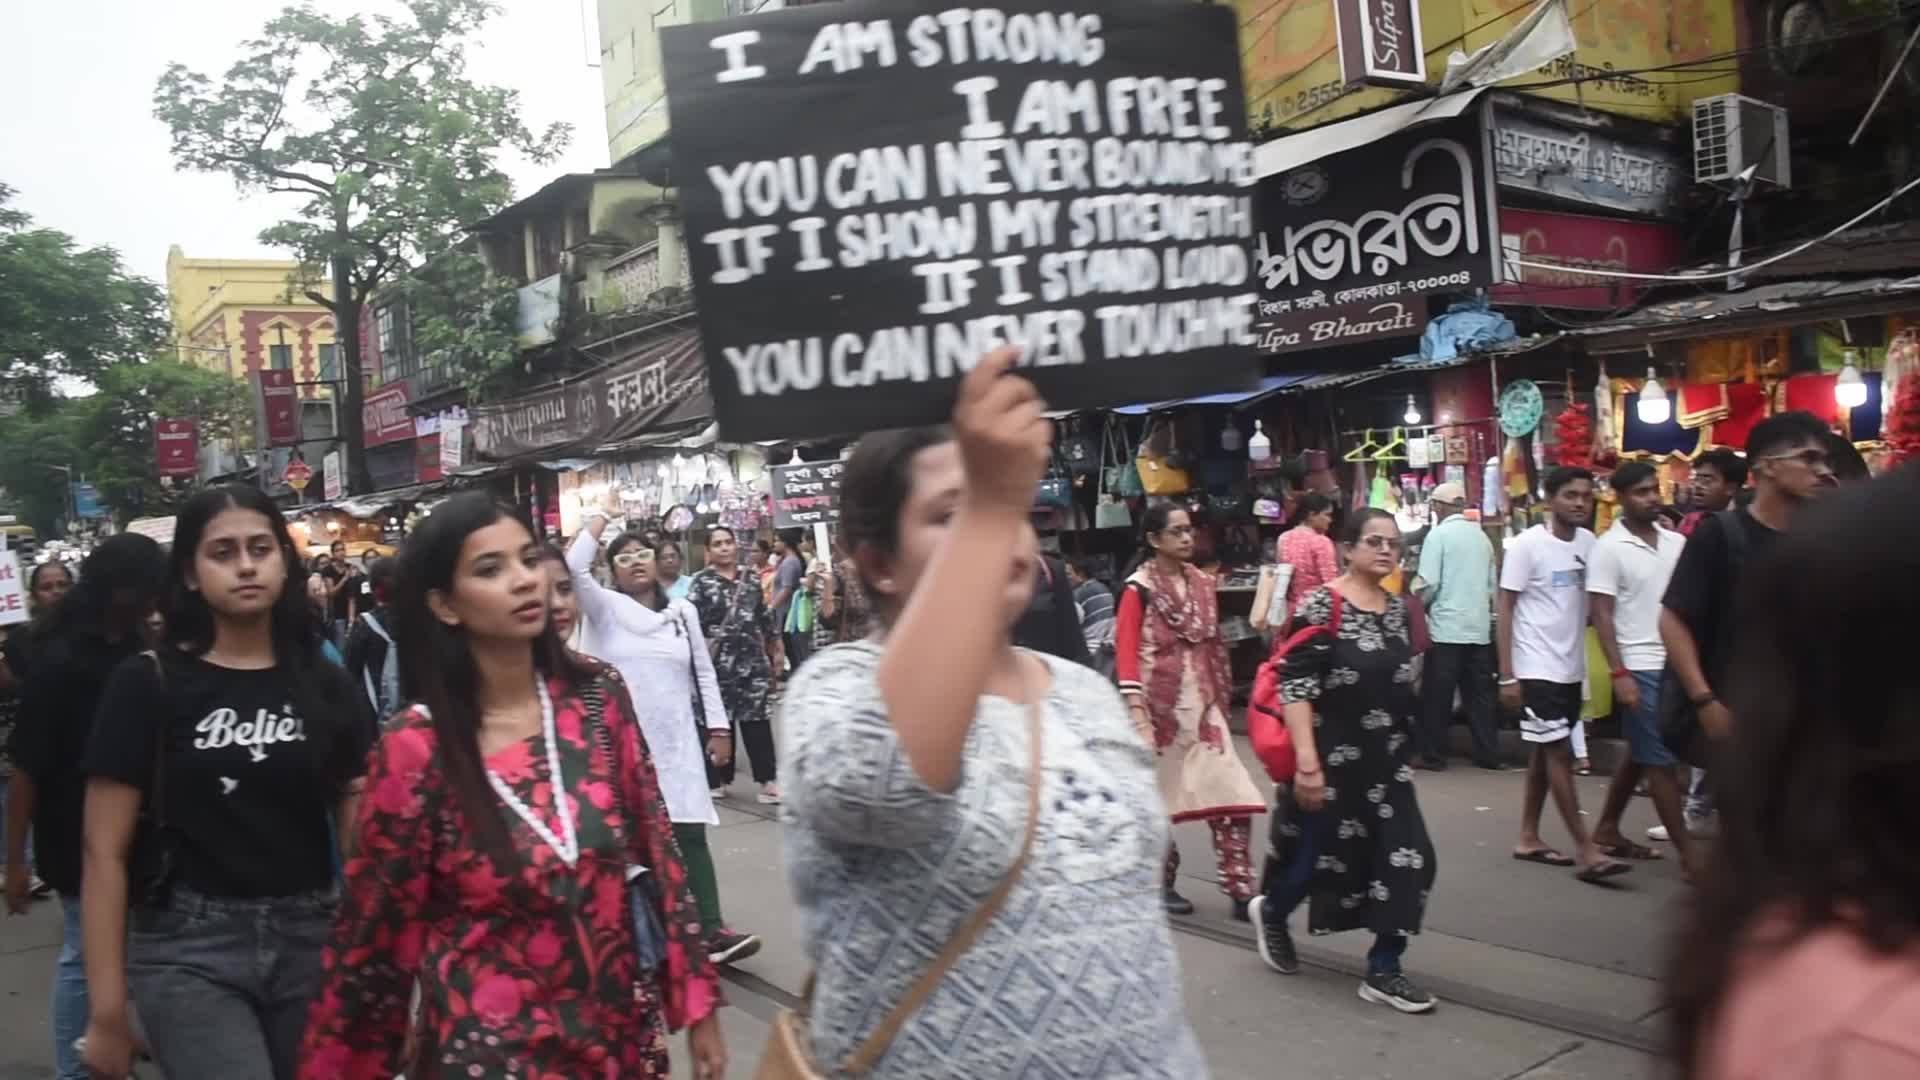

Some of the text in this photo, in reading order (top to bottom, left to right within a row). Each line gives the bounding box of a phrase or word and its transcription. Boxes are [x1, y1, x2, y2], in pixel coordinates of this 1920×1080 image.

[709, 8, 1105, 83] I AM STRONG
[1371, 0, 1403, 71] Silpa
[953, 75, 1232, 140] I AM FREE
[707, 155, 818, 220] YOU
[825, 146, 926, 209] CAN
[934, 138, 1091, 197] NEVER
[703, 193, 1252, 284] IF I SHOW MY STRENGTH
[912, 244, 1249, 315] IF I STAND LOUD
[723, 337, 821, 396] YOU
[830, 326, 930, 389] CAN
[934, 309, 1087, 379] NEVER
[1256, 302, 1416, 352] ilpa Bharati
